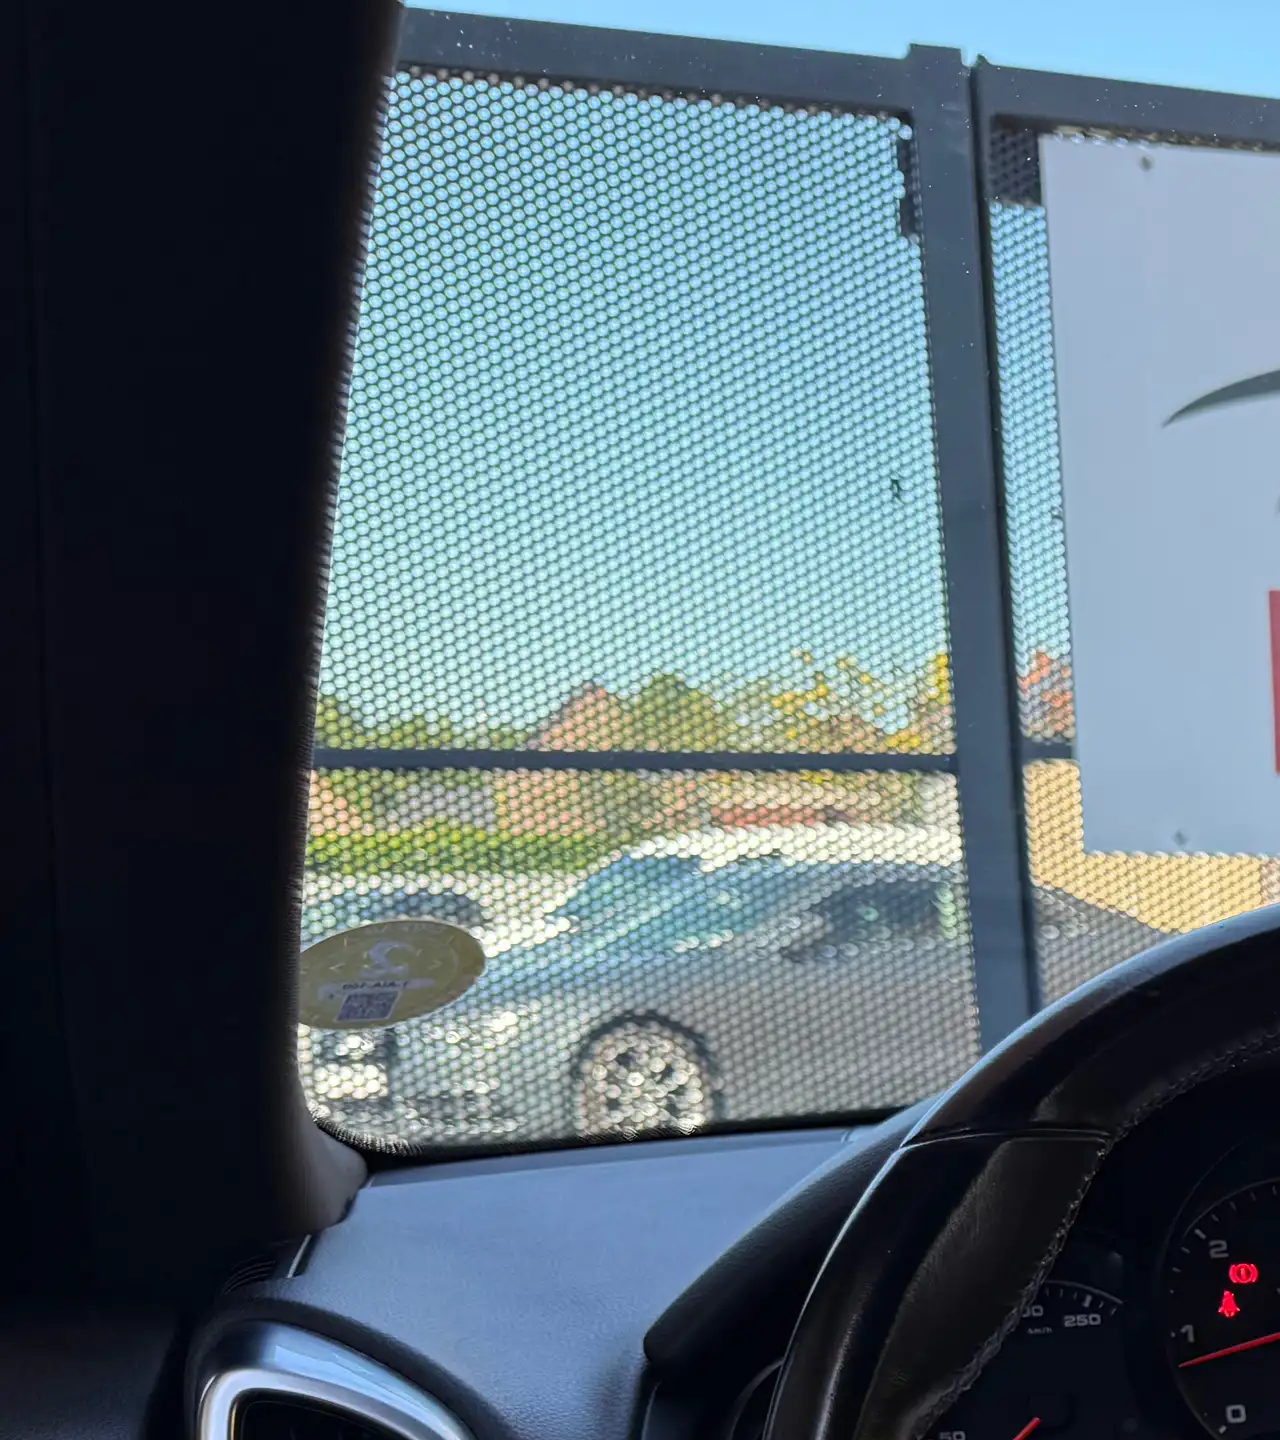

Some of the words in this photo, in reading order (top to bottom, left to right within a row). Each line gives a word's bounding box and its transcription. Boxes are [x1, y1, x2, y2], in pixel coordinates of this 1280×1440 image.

[1208, 1240, 1229, 1258] 2
[1064, 1312, 1102, 1328] 250
[1180, 1326, 1195, 1344] 1
[1226, 1406, 1246, 1424] 0
